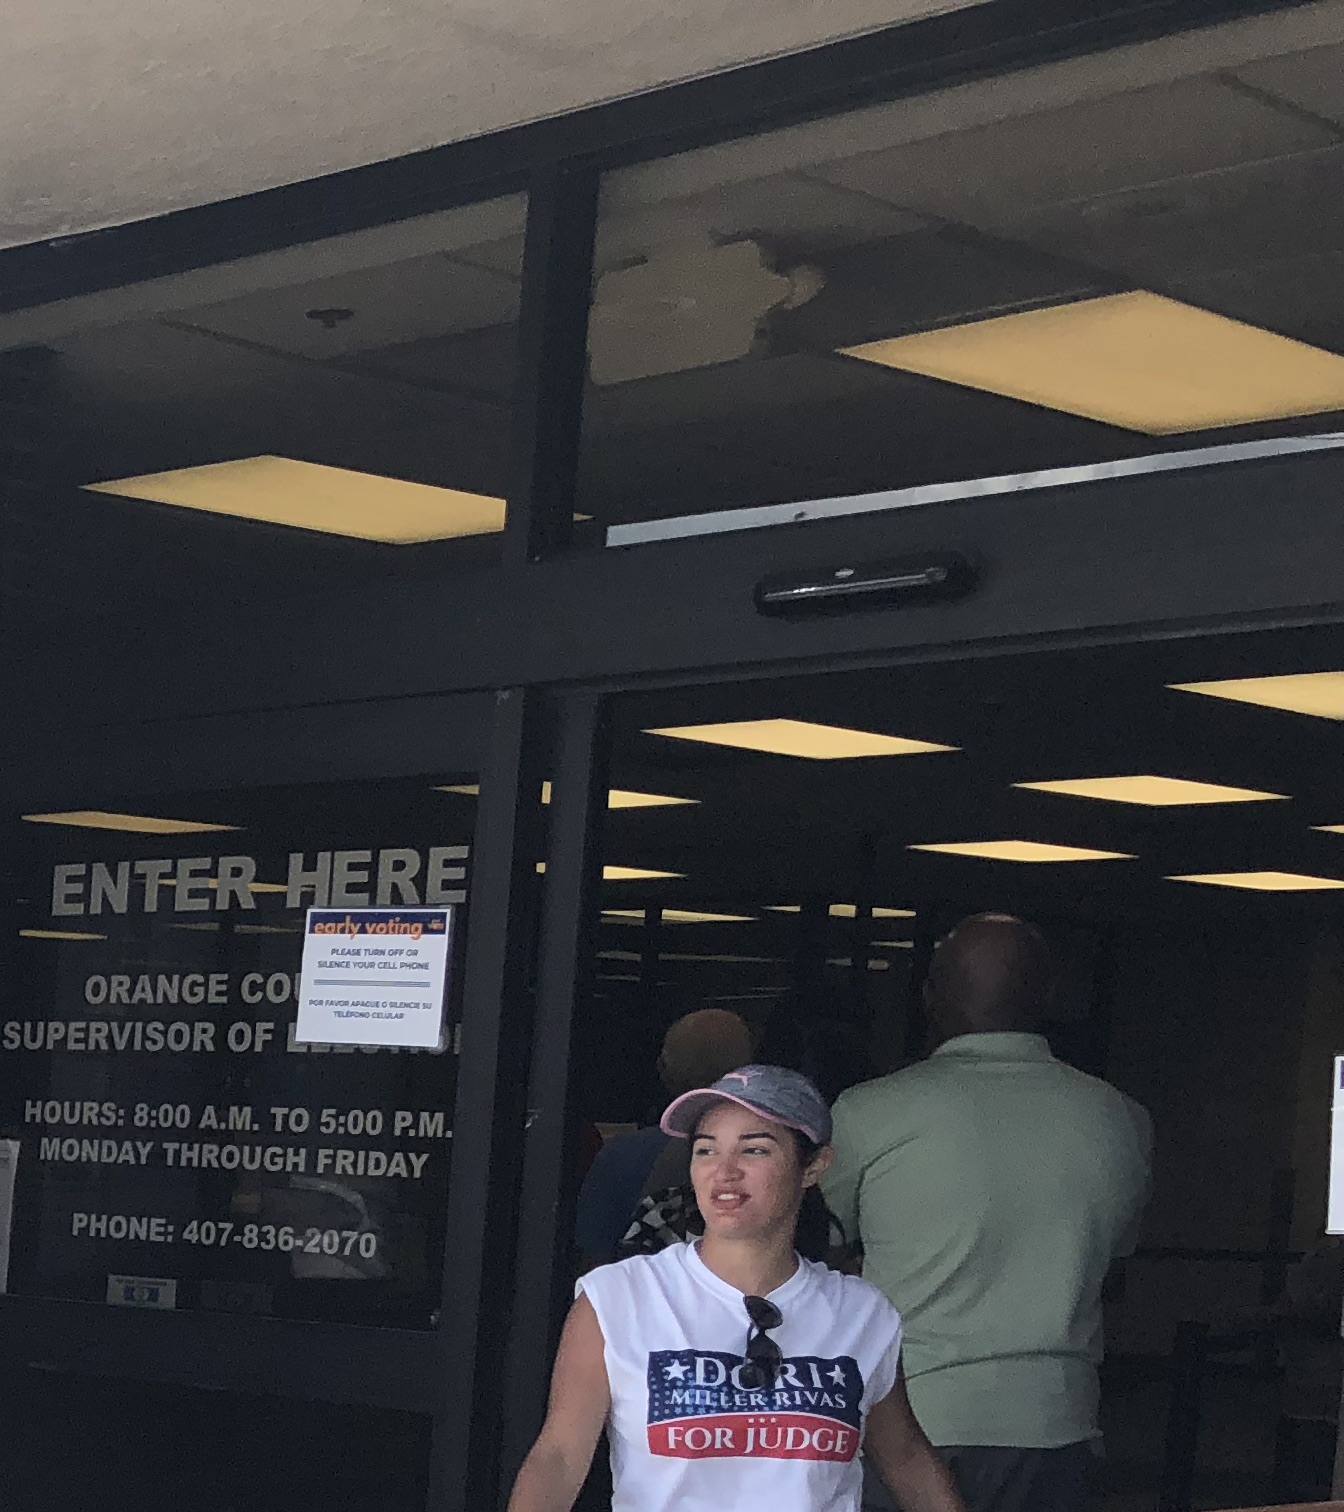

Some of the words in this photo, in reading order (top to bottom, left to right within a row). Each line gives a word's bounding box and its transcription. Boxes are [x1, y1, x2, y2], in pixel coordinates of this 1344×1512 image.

[51, 856, 258, 917] ENTER
[285, 845, 470, 909] HERE
[314, 915, 362, 940] early
[365, 916, 423, 940] voting
[317, 960, 350, 969] SILENCE
[352, 961, 375, 969] YOUR
[377, 961, 397, 970] CELL
[399, 961, 430, 970] PHONE
[330, 947, 361, 957] PLEASE
[364, 948, 386, 957] TURN
[388, 948, 404, 957] OFF
[406, 949, 419, 957] OR
[84, 973, 229, 1005] ORANGE
[240, 972, 302, 1005] CO
[325, 999, 349, 1007] FAVOR
[2, 1020, 216, 1053] SUPERVISOR
[227, 1021, 275, 1053] OF
[24, 1100, 125, 1128] HOURS:
[133, 1103, 191, 1129] 8:00
[198, 1105, 260, 1132] A.M.
[270, 1107, 310, 1134] TO
[319, 1108, 384, 1137] 5:00
[393, 1110, 454, 1140] P.M.
[39, 1136, 154, 1167] MONDAY
[162, 1142, 307, 1174] THROUGH
[316, 1148, 430, 1180] FRIDAY
[71, 1211, 175, 1245] PHONE:
[182, 1218, 378, 1260] 407-836-2070
[669, 1388, 767, 1407] MILLER
[775, 1390, 846, 1409] RIVAS
[667, 1426, 735, 1450] FOR
[744, 1426, 851, 1454] JUDGE
